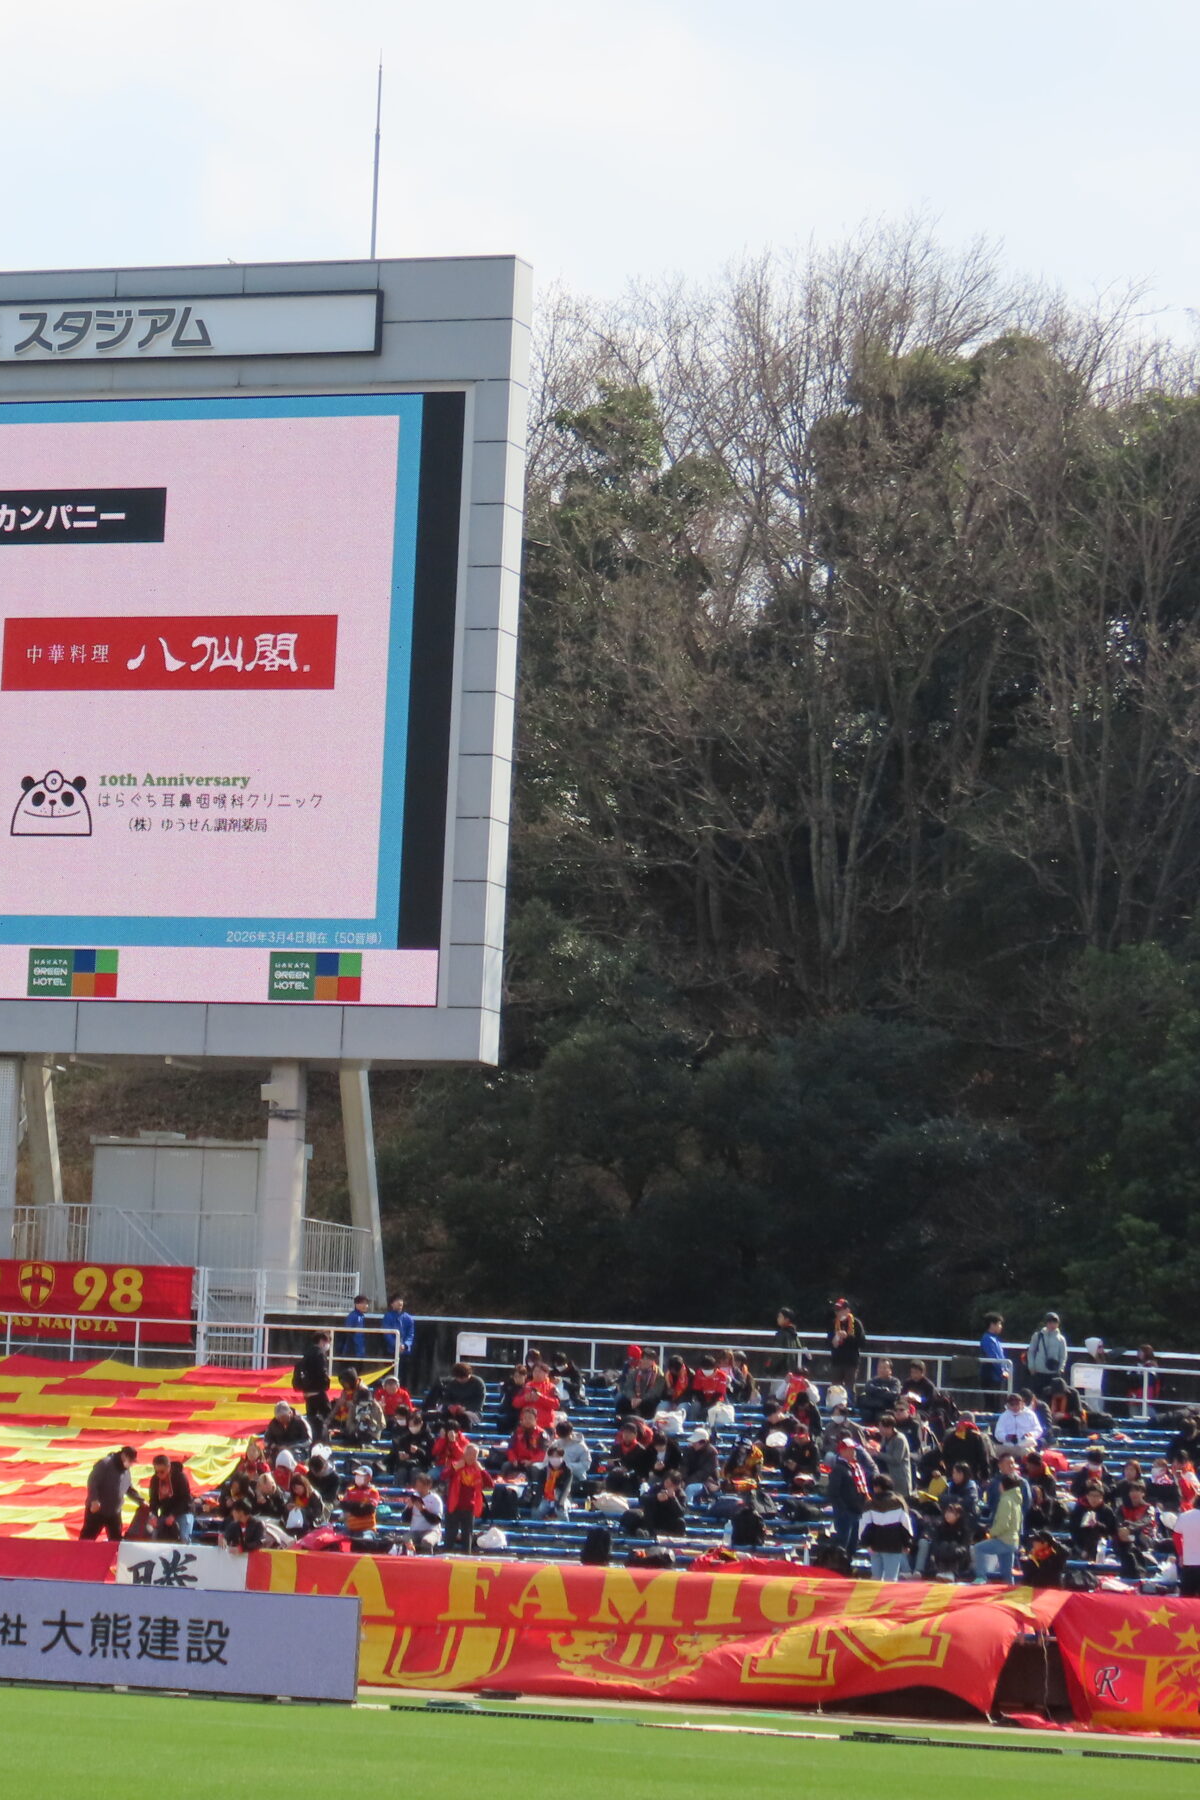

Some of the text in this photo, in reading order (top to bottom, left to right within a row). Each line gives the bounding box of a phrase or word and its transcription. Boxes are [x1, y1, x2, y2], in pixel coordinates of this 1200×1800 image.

[14, 306, 212, 353] スタジアム
[26, 643, 110, 664] 中華料理
[98, 773, 251, 789] 10th Anniversary
[97, 792, 323, 810] はらぐち耳鼻咽喉科クリニック
[33, 967, 68, 976] GREEN
[274, 970, 310, 979] GREEN
[32, 978, 66, 987] HOTEL
[273, 981, 309, 990] HOTEL
[73, 1266, 144, 1314] 98
[41, 1610, 231, 1667] 大熊建設
